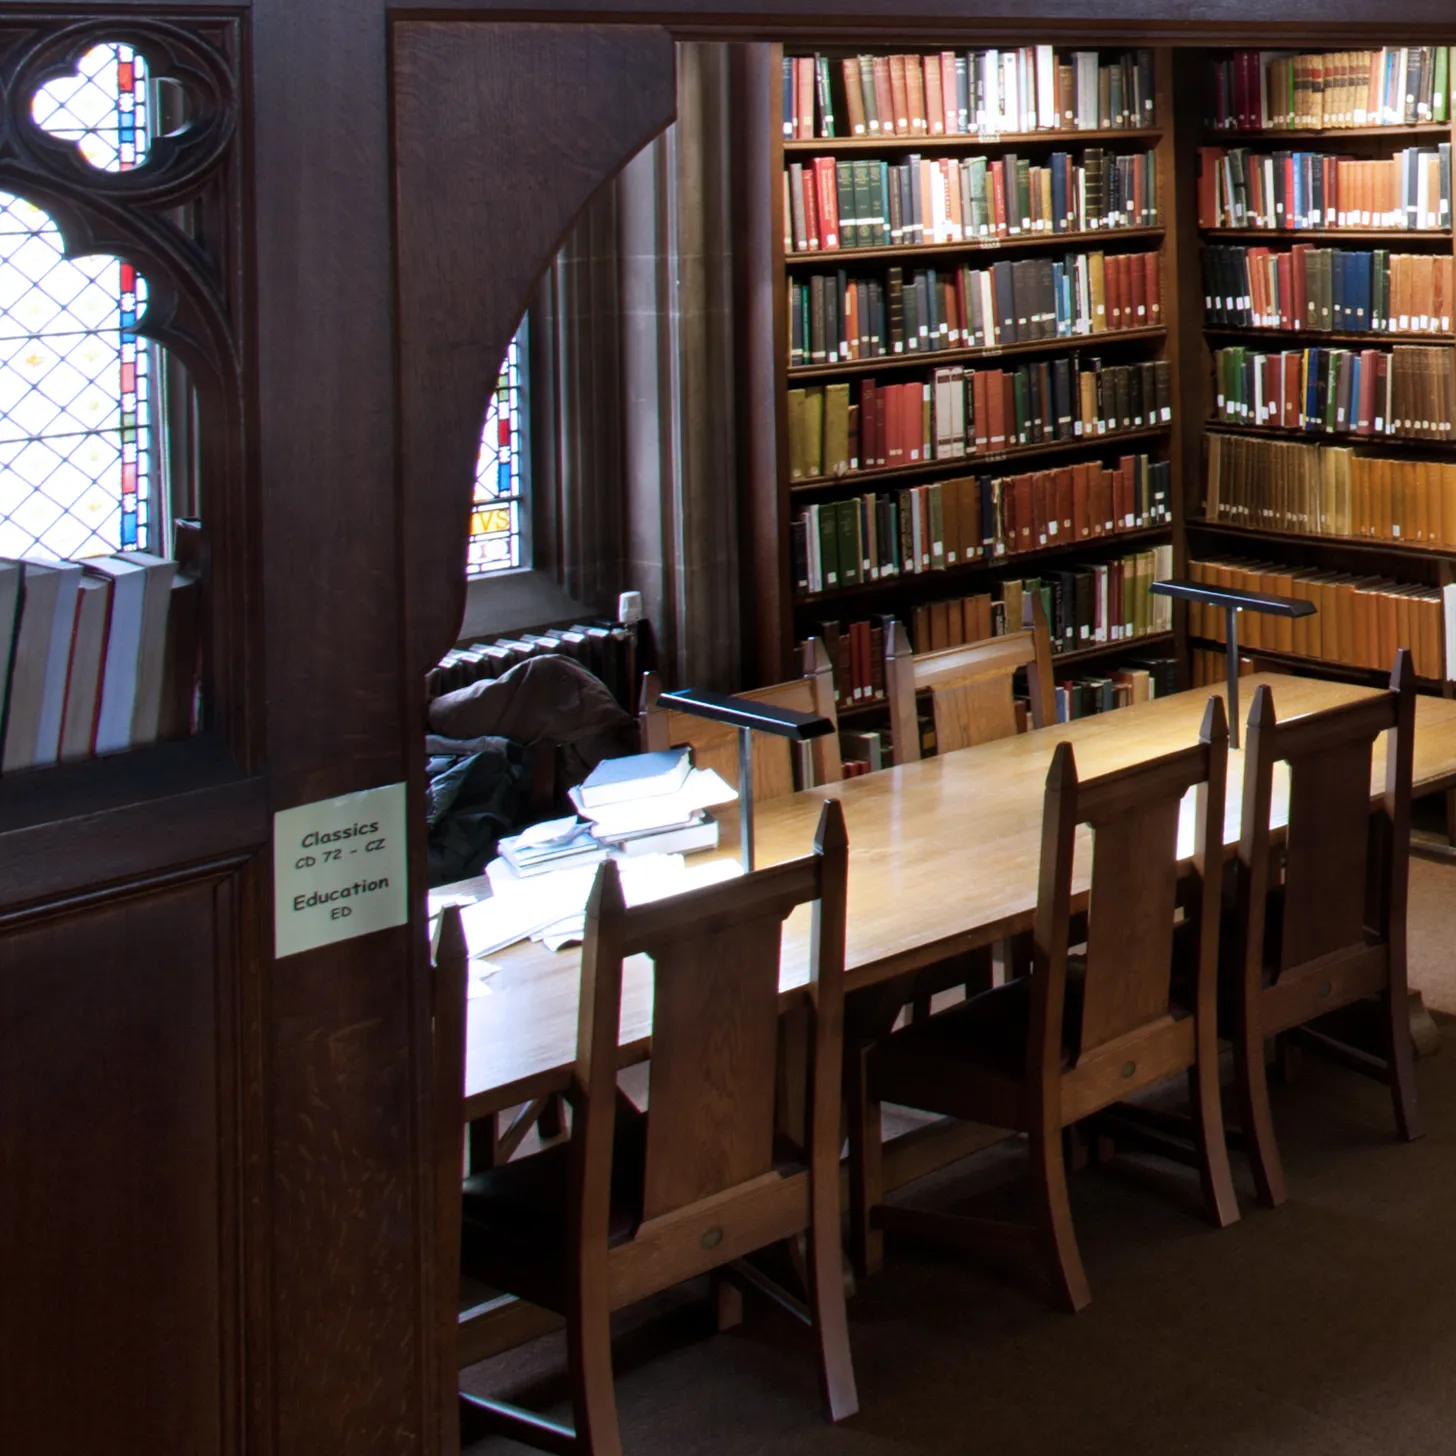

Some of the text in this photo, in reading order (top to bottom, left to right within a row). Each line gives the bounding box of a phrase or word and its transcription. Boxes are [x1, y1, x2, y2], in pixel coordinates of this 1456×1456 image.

[301, 821, 379, 848] Classics
[295, 856, 316, 870] CD
[323, 848, 343, 863] 72
[365, 838, 386, 853] CZ
[293, 877, 389, 911] Education
[331, 906, 352, 920] ED
